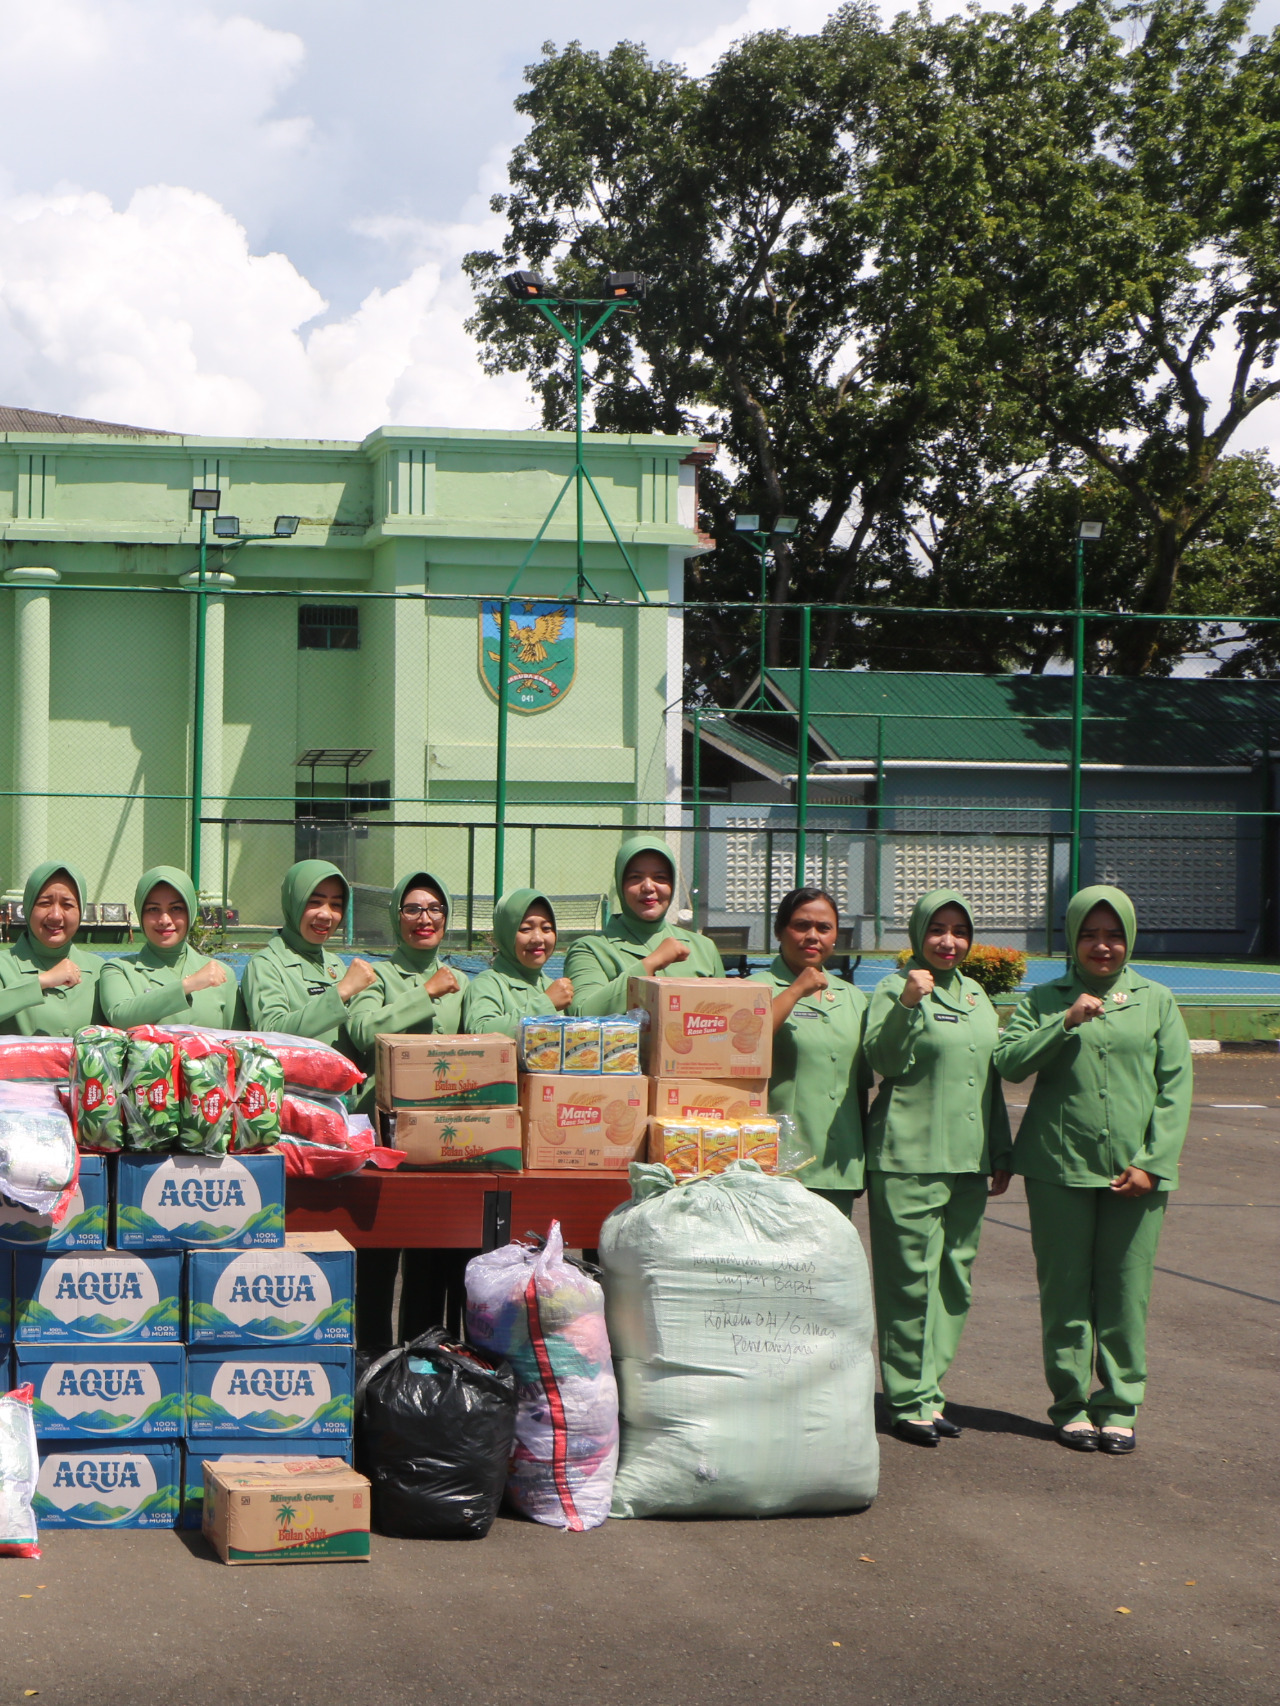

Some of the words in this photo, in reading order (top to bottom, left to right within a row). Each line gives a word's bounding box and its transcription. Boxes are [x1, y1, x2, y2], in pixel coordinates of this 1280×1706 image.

[687, 1016, 726, 1028] Marie
[427, 1049, 456, 1058] Minyak
[457, 1049, 485, 1058] Goreng
[435, 1080, 457, 1091] Bulan
[459, 1079, 478, 1091] Sabit
[560, 1107, 599, 1119] Marie
[686, 1109, 722, 1120] Marie
[434, 1116, 463, 1125] Minyak
[463, 1115, 491, 1124] Goreng
[441, 1146, 462, 1157] Bulan
[464, 1145, 484, 1157] Sabit
[158, 1178, 246, 1212] AQUA
[55, 1271, 143, 1305] AQUA
[229, 1274, 317, 1308] AQUA
[57, 1368, 145, 1400] AQUA
[227, 1368, 315, 1400] AQUA
[53, 1460, 141, 1493] AQUA
[270, 1493, 303, 1504] Minyak
[303, 1493, 335, 1503] Goreng
[278, 1529, 304, 1541] Bulan
[305, 1528, 327, 1542] Sabit
